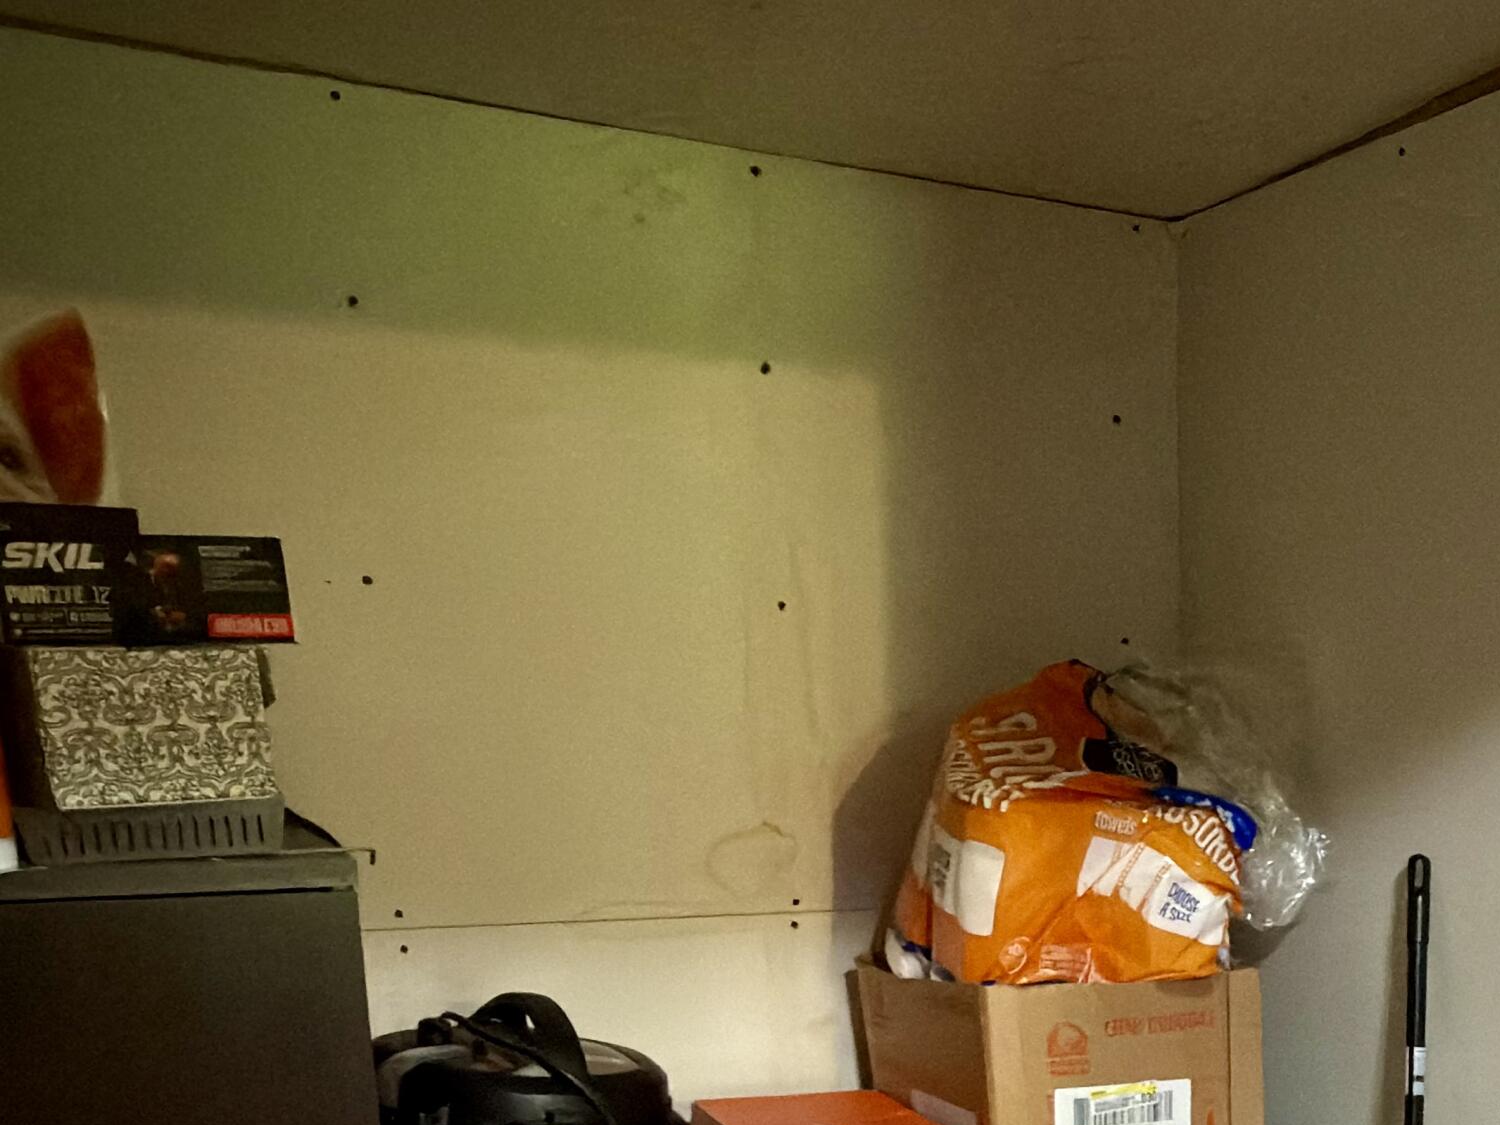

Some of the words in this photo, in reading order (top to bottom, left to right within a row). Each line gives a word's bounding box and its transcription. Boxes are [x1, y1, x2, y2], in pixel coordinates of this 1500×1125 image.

[2, 541, 104, 573] SKIL
[1095, 810, 1137, 835] towels
[1168, 881, 1201, 913] CHOOSE
[1158, 901, 1169, 918] A
[1170, 906, 1193, 923] SIZE
